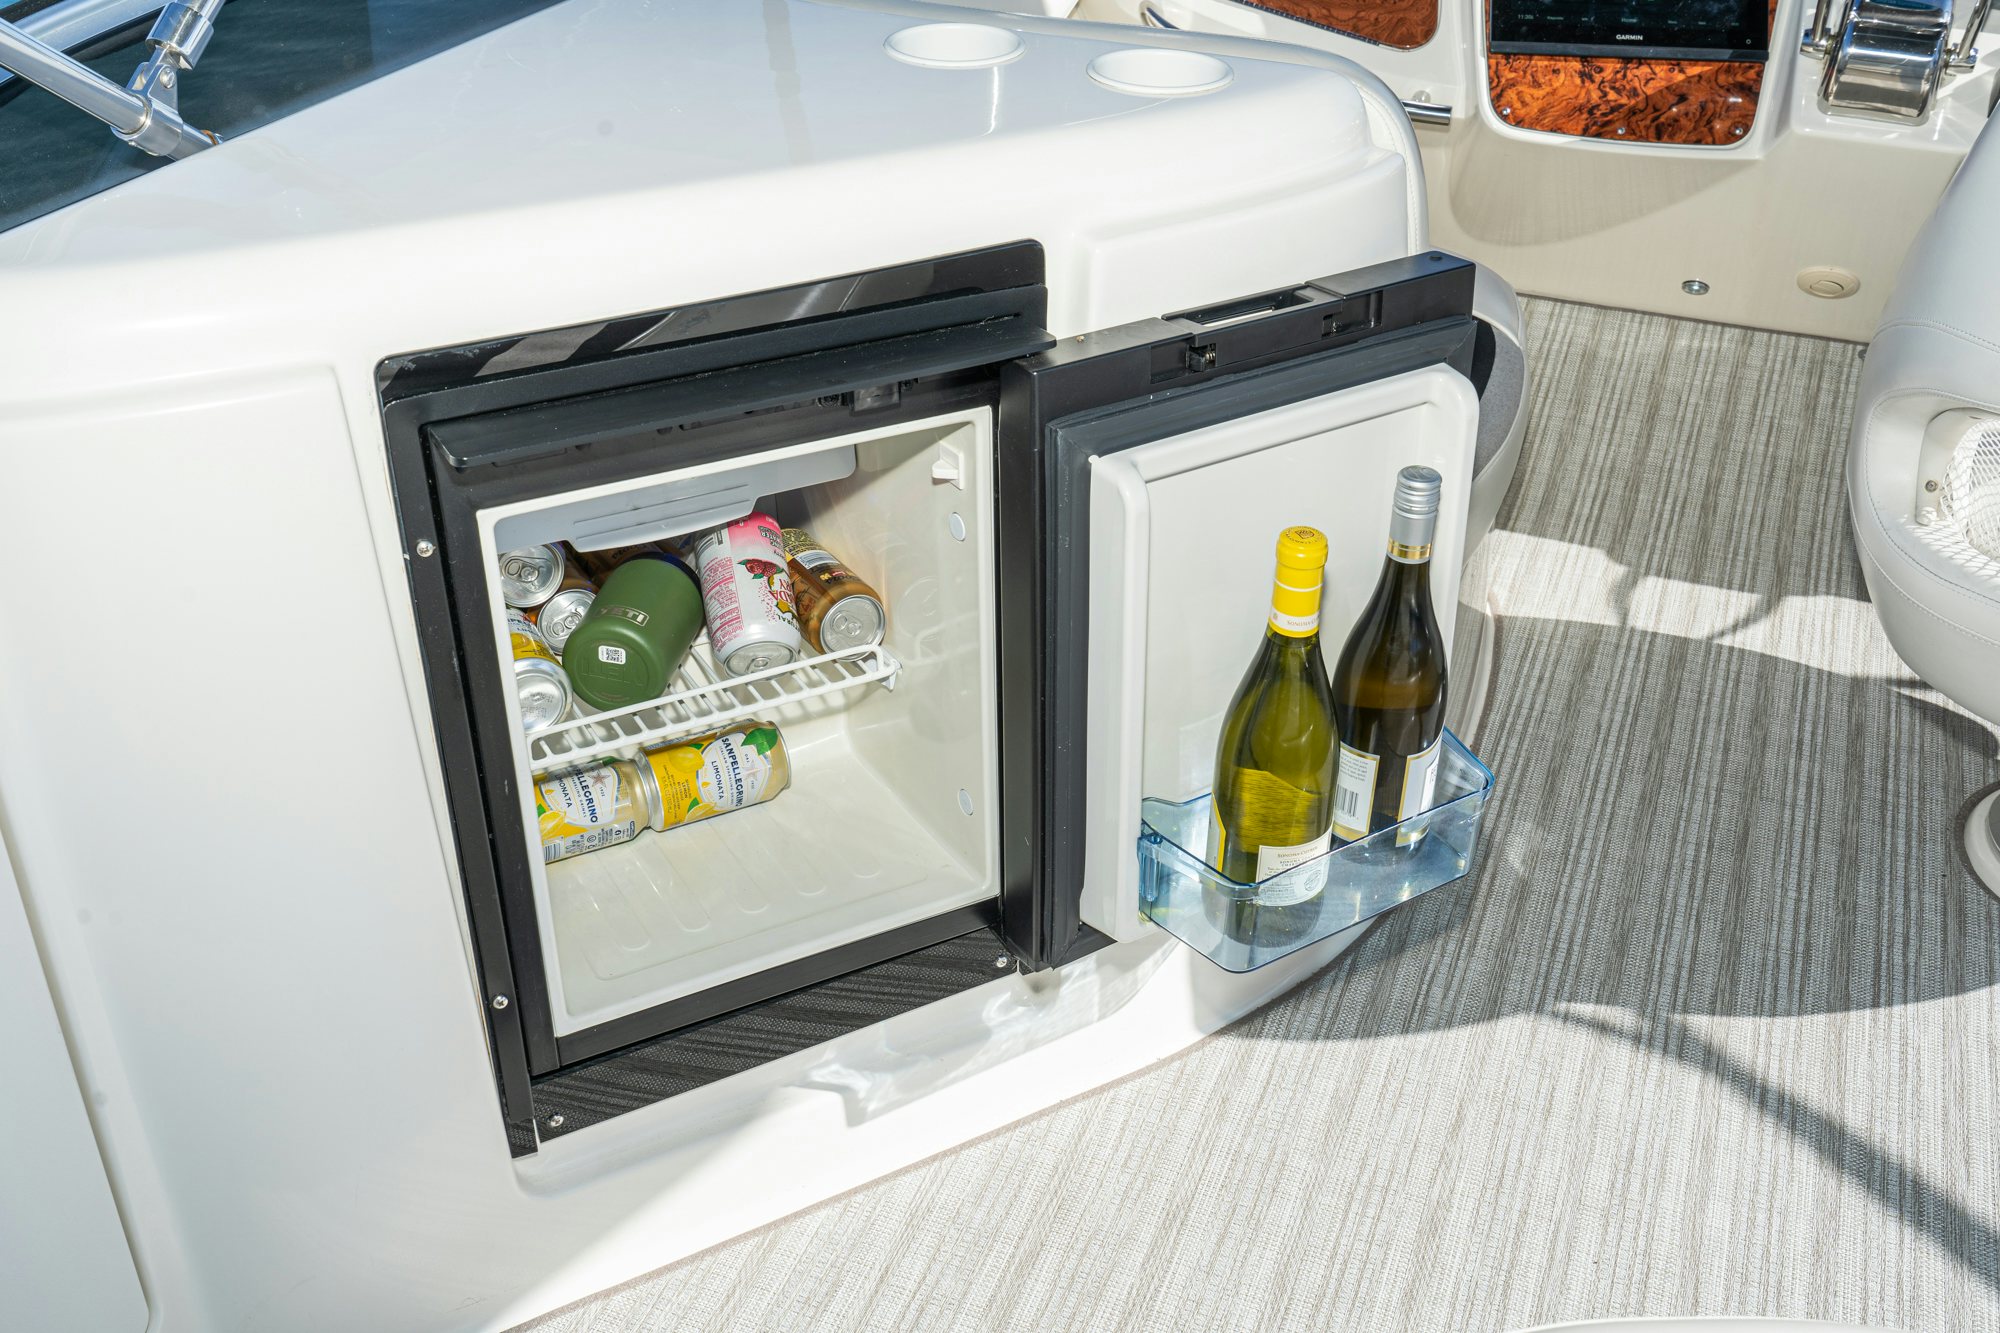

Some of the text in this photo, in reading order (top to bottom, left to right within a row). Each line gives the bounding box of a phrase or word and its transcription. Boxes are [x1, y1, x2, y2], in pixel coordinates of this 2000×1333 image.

[600, 607, 645, 623] YETI
[574, 766, 599, 823] PELLEGRINO
[711, 760, 724, 800] LIMONATA
